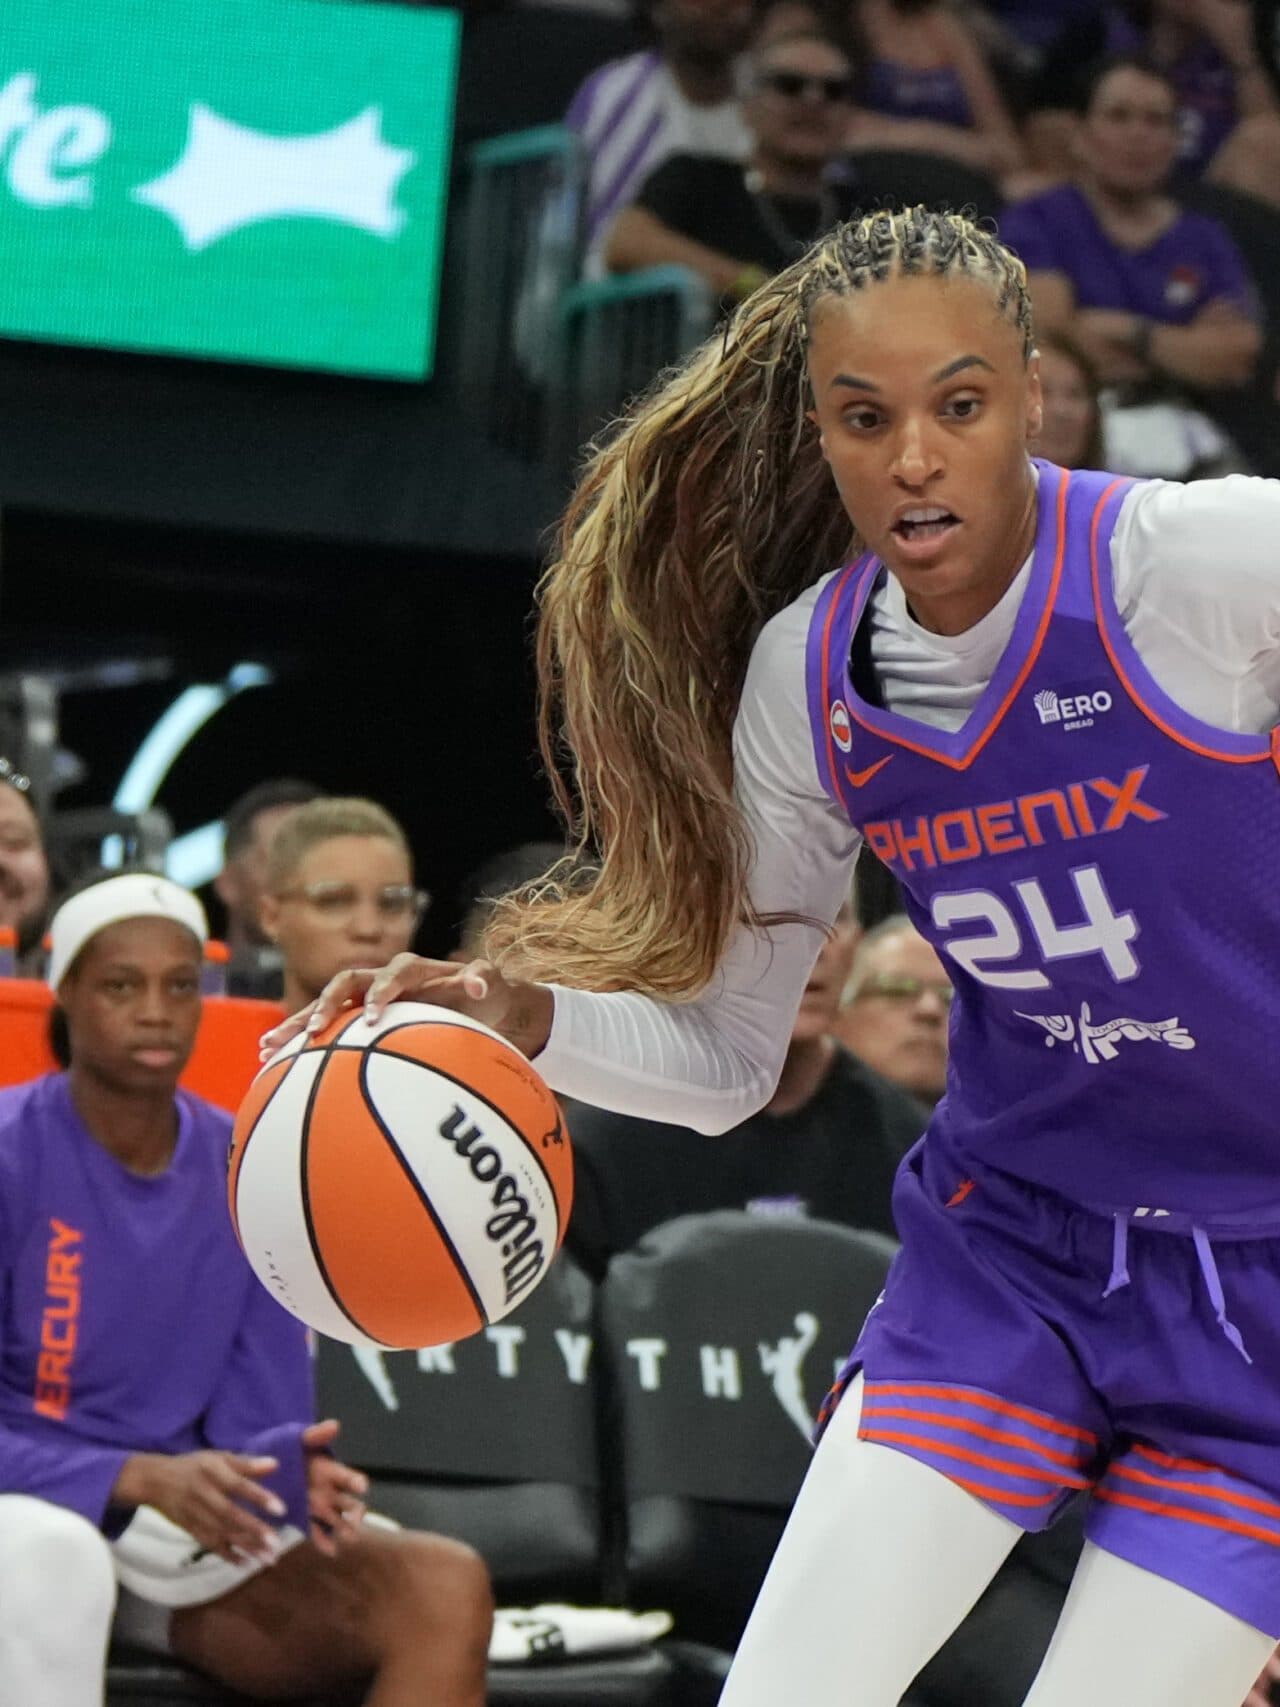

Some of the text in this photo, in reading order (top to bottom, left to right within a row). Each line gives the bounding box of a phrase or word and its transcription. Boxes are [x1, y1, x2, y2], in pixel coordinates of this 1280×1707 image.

[863, 764, 1169, 872] PHOENIX
[930, 863, 1142, 990] 24
[438, 1101, 546, 1307] Wilson
[33, 1218, 84, 1421] ERCURY
